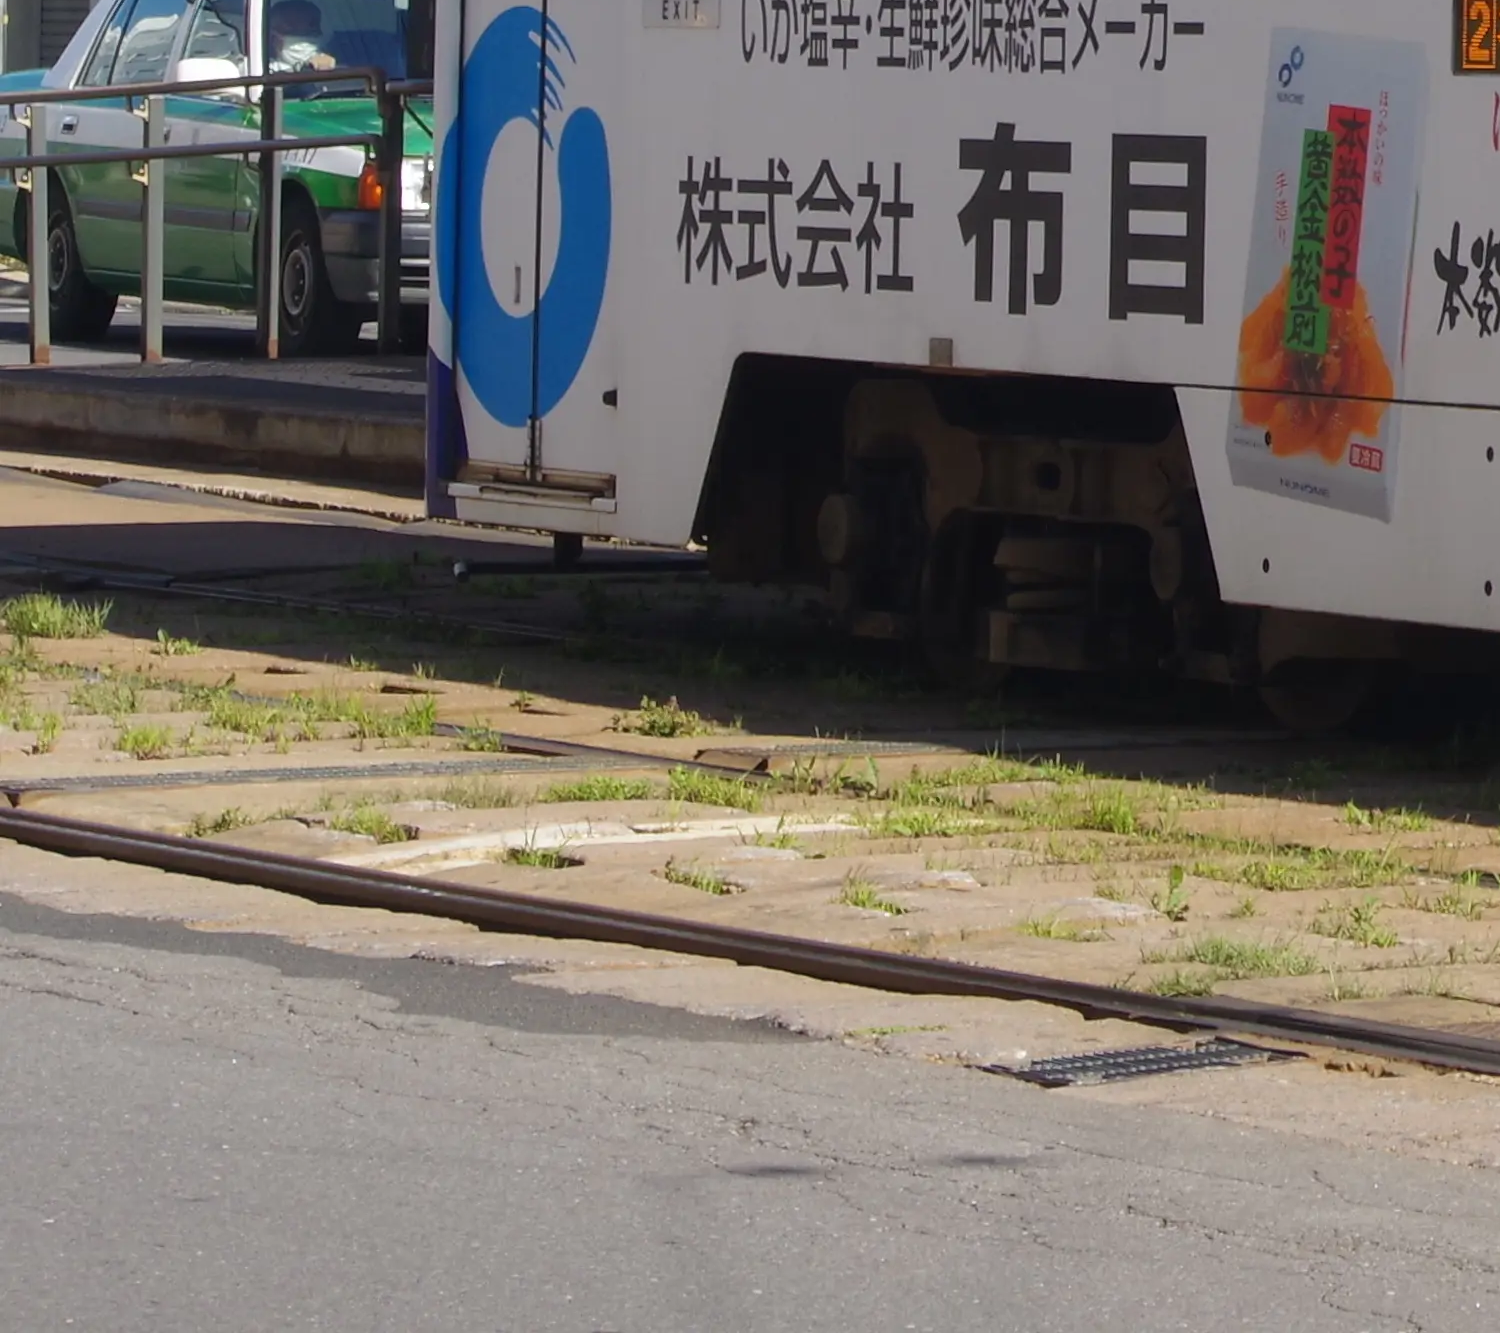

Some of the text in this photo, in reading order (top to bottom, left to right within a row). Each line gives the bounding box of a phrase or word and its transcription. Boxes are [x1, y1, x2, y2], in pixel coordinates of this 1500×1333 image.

[661, 0, 701, 21] EXIT
[677, 121, 1208, 325] 株式会社 布目
